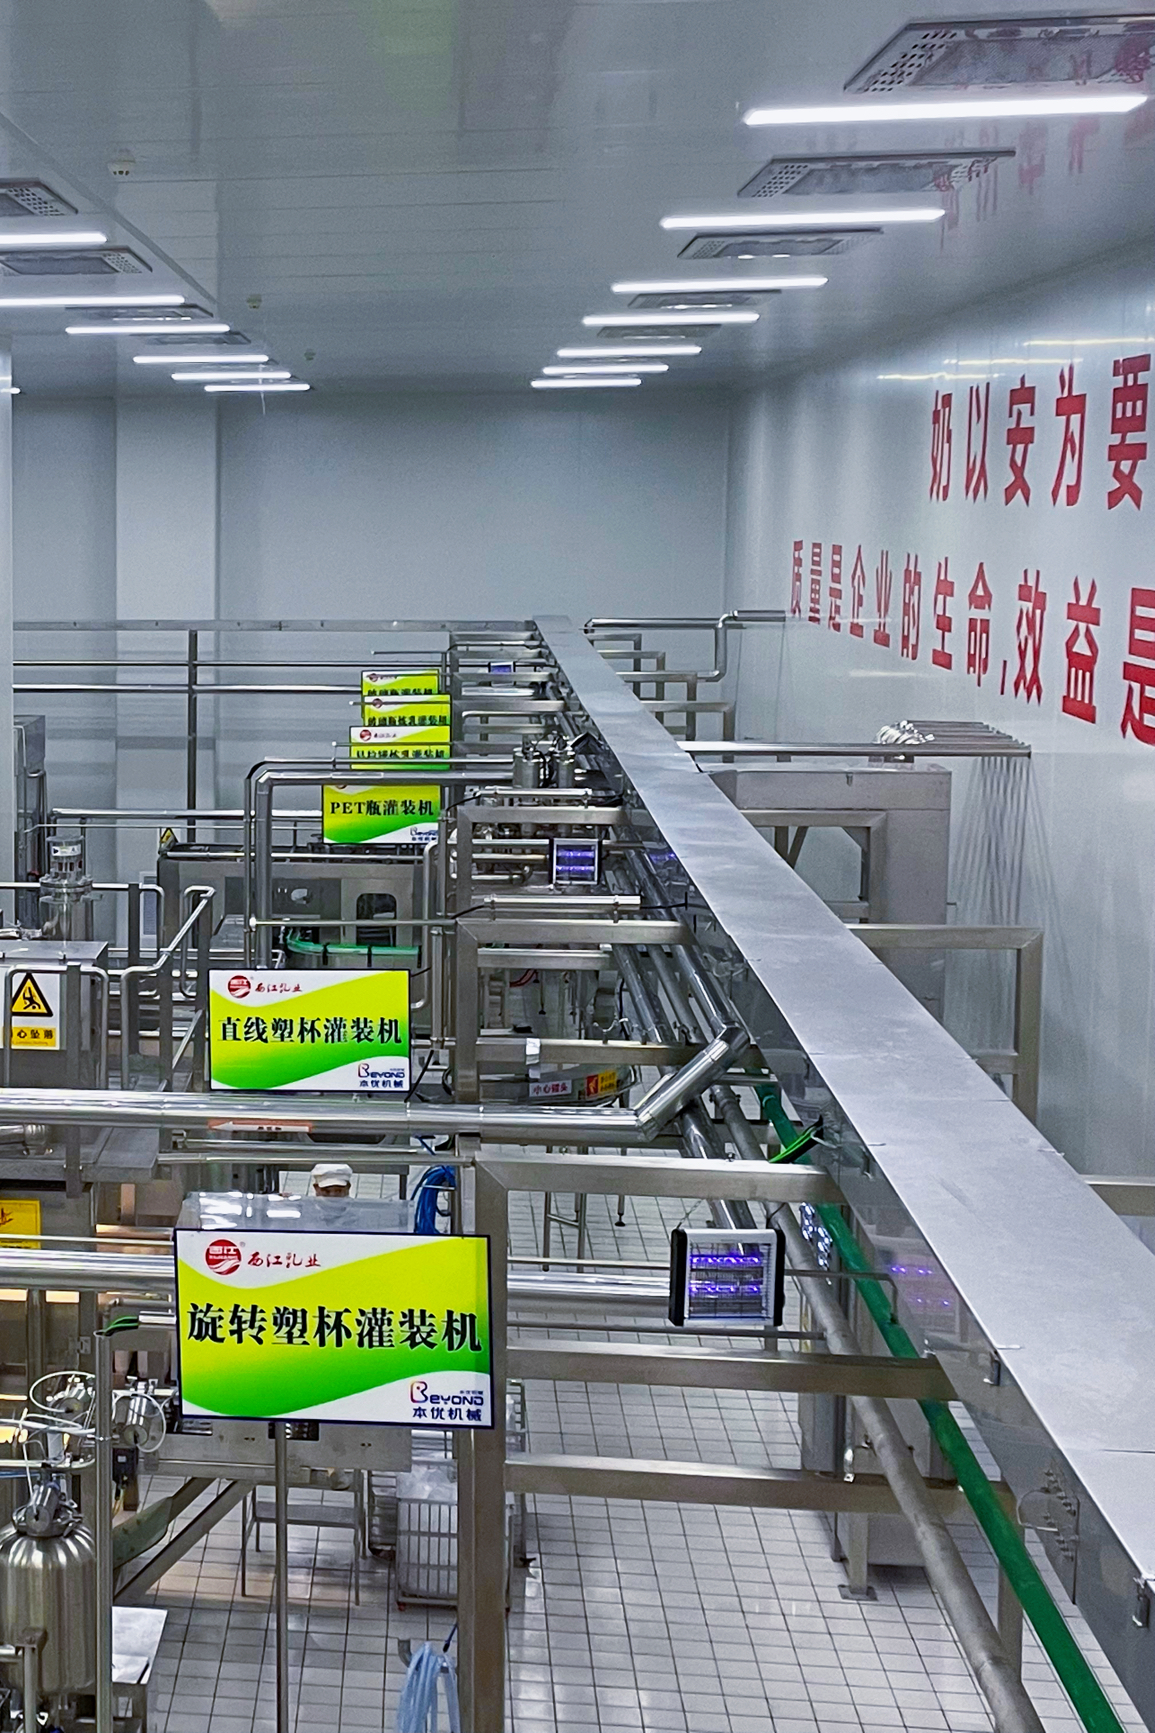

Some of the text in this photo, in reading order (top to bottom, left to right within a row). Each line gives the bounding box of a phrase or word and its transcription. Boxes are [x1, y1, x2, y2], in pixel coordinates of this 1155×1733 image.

[929, 353, 1151, 511] 奶以安为要
[330, 799, 434, 816] PET瓶灌装机
[10, 1029, 53, 1039] 心坠落
[218, 1016, 402, 1045] 直线塑杯灌装机
[247, 1251, 322, 1268] 西江乳业
[187, 1302, 482, 1351] 旋转塑杯灌装机
[412, 1406, 482, 1421] 本优机械
